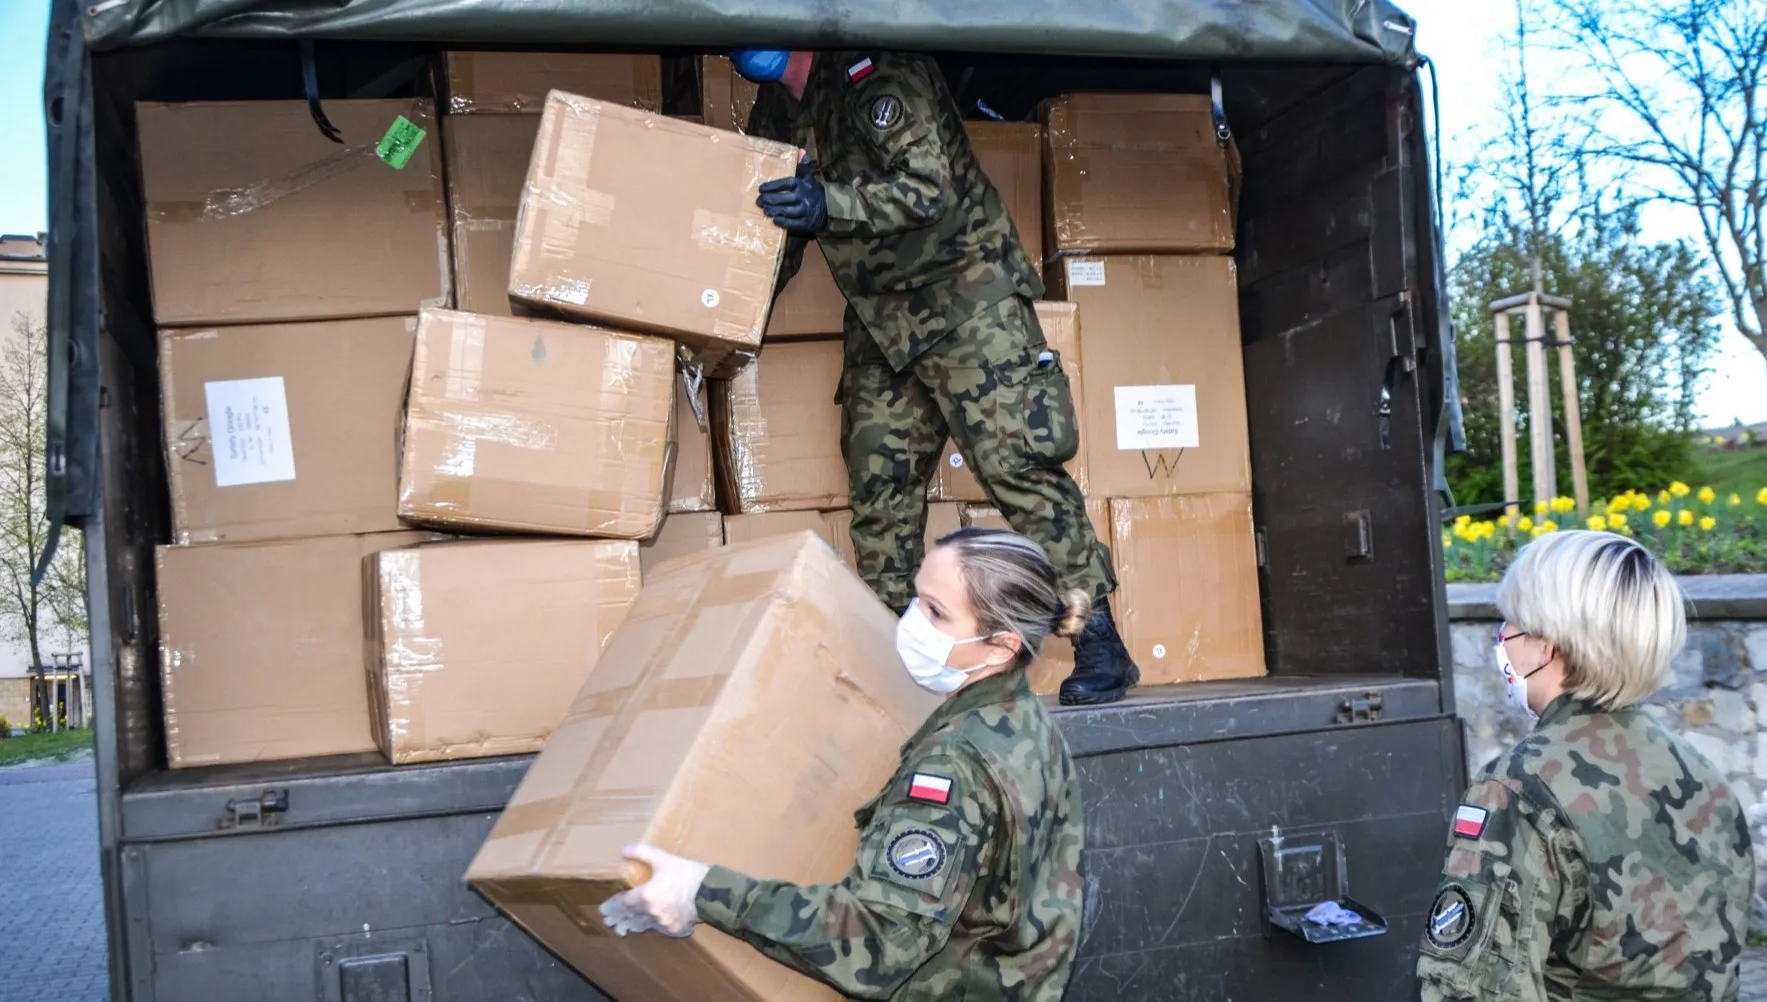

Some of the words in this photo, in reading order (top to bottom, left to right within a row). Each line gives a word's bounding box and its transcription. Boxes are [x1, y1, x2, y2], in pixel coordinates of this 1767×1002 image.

[225, 405, 234, 434] Google
[1160, 427, 1179, 436] Safety
[228, 435, 238, 460] Safety
